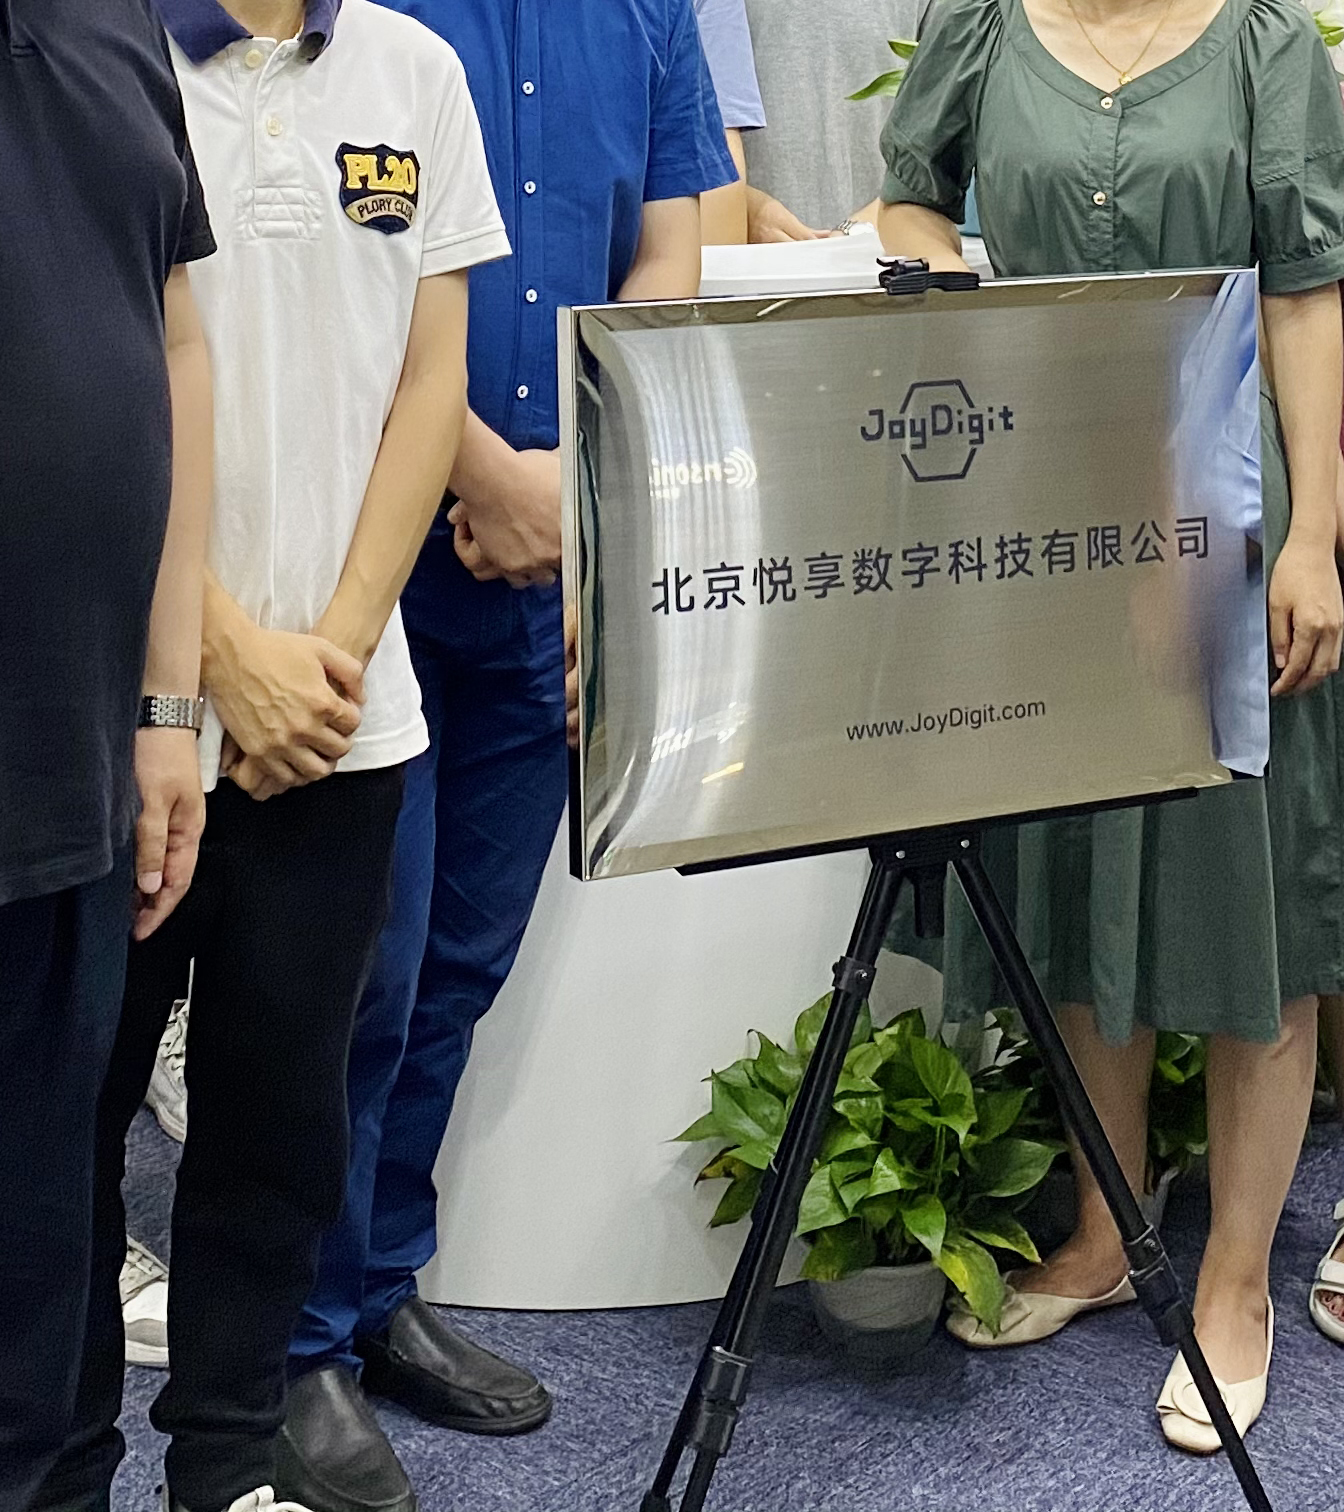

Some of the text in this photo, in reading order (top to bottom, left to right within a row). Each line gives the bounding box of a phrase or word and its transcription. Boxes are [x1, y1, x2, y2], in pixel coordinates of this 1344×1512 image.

[860, 404, 1014, 450] JoyDigit
[650, 516, 1210, 617] 北京悦享数字科技有限公司
[846, 698, 1046, 742] www.JoyDigit.com
